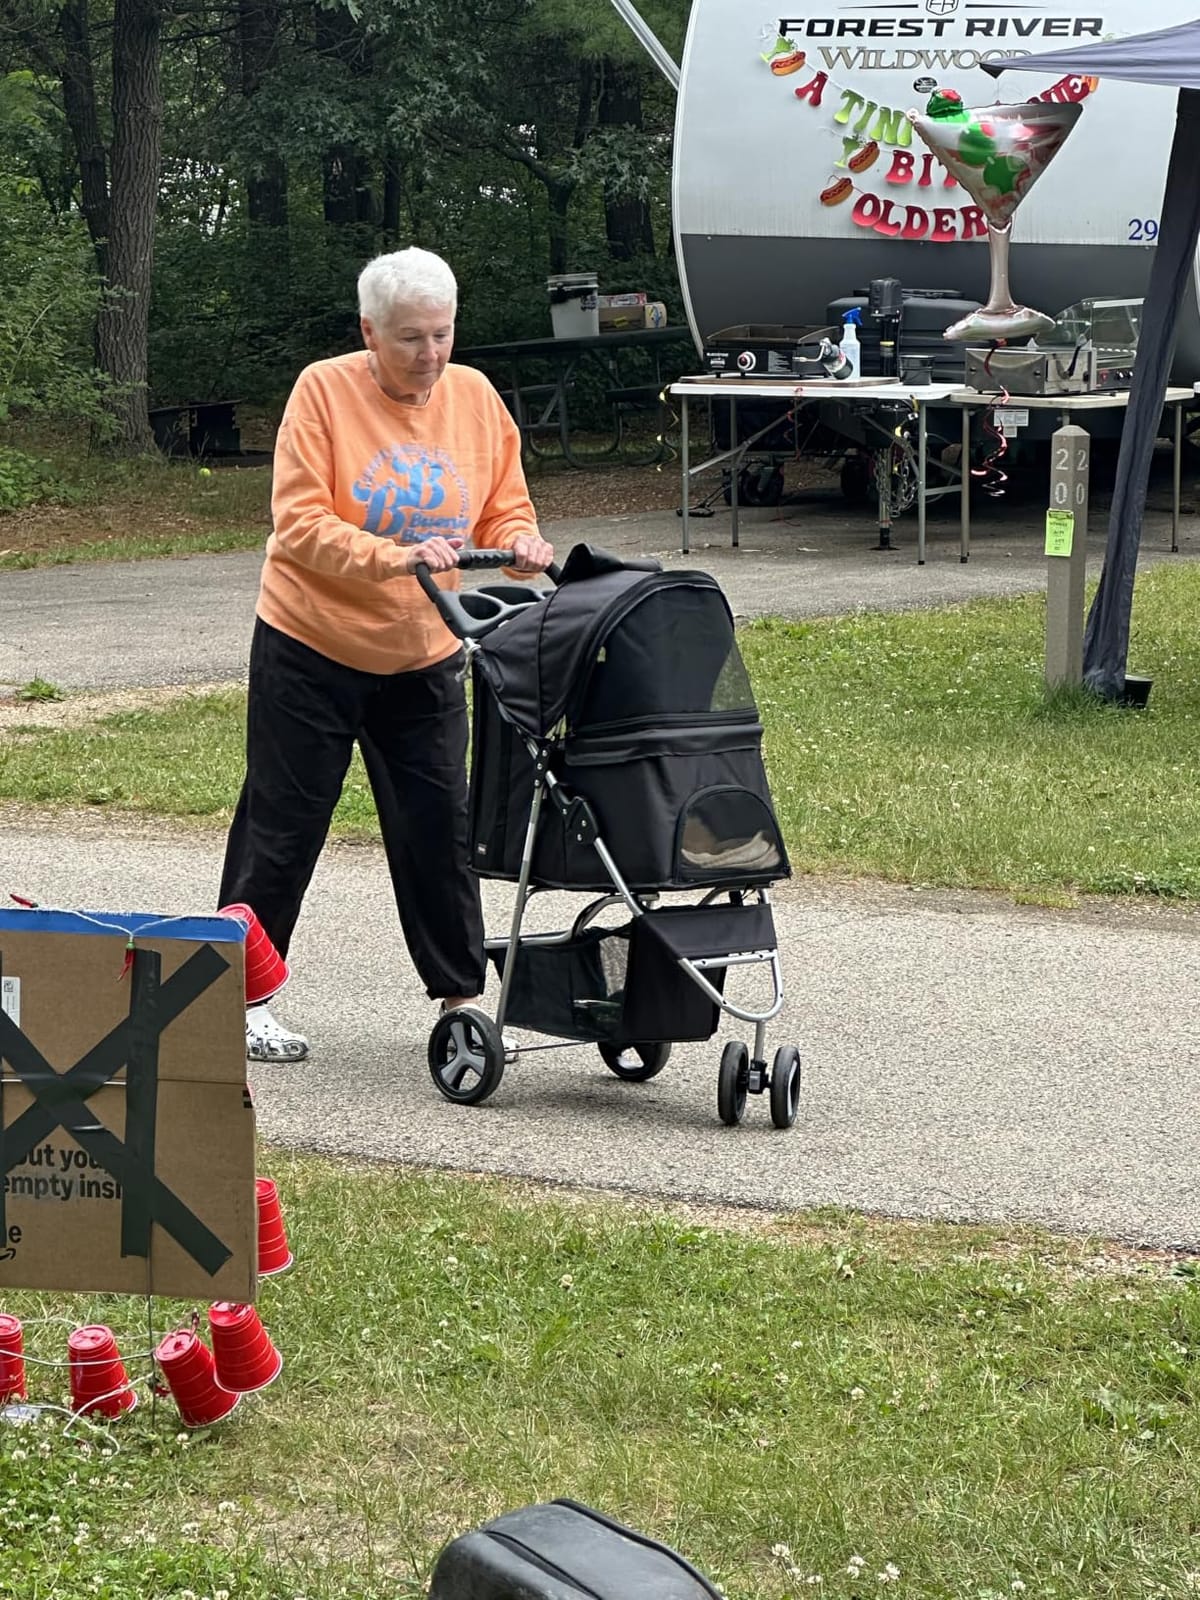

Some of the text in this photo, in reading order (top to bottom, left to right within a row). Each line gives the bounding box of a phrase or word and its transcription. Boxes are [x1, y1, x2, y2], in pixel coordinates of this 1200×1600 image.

[779, 18, 1104, 37] FOREST RIVER
[795, 71, 828, 107] A
[852, 193, 989, 242] OLDER
[1128, 218, 1158, 241] 29
